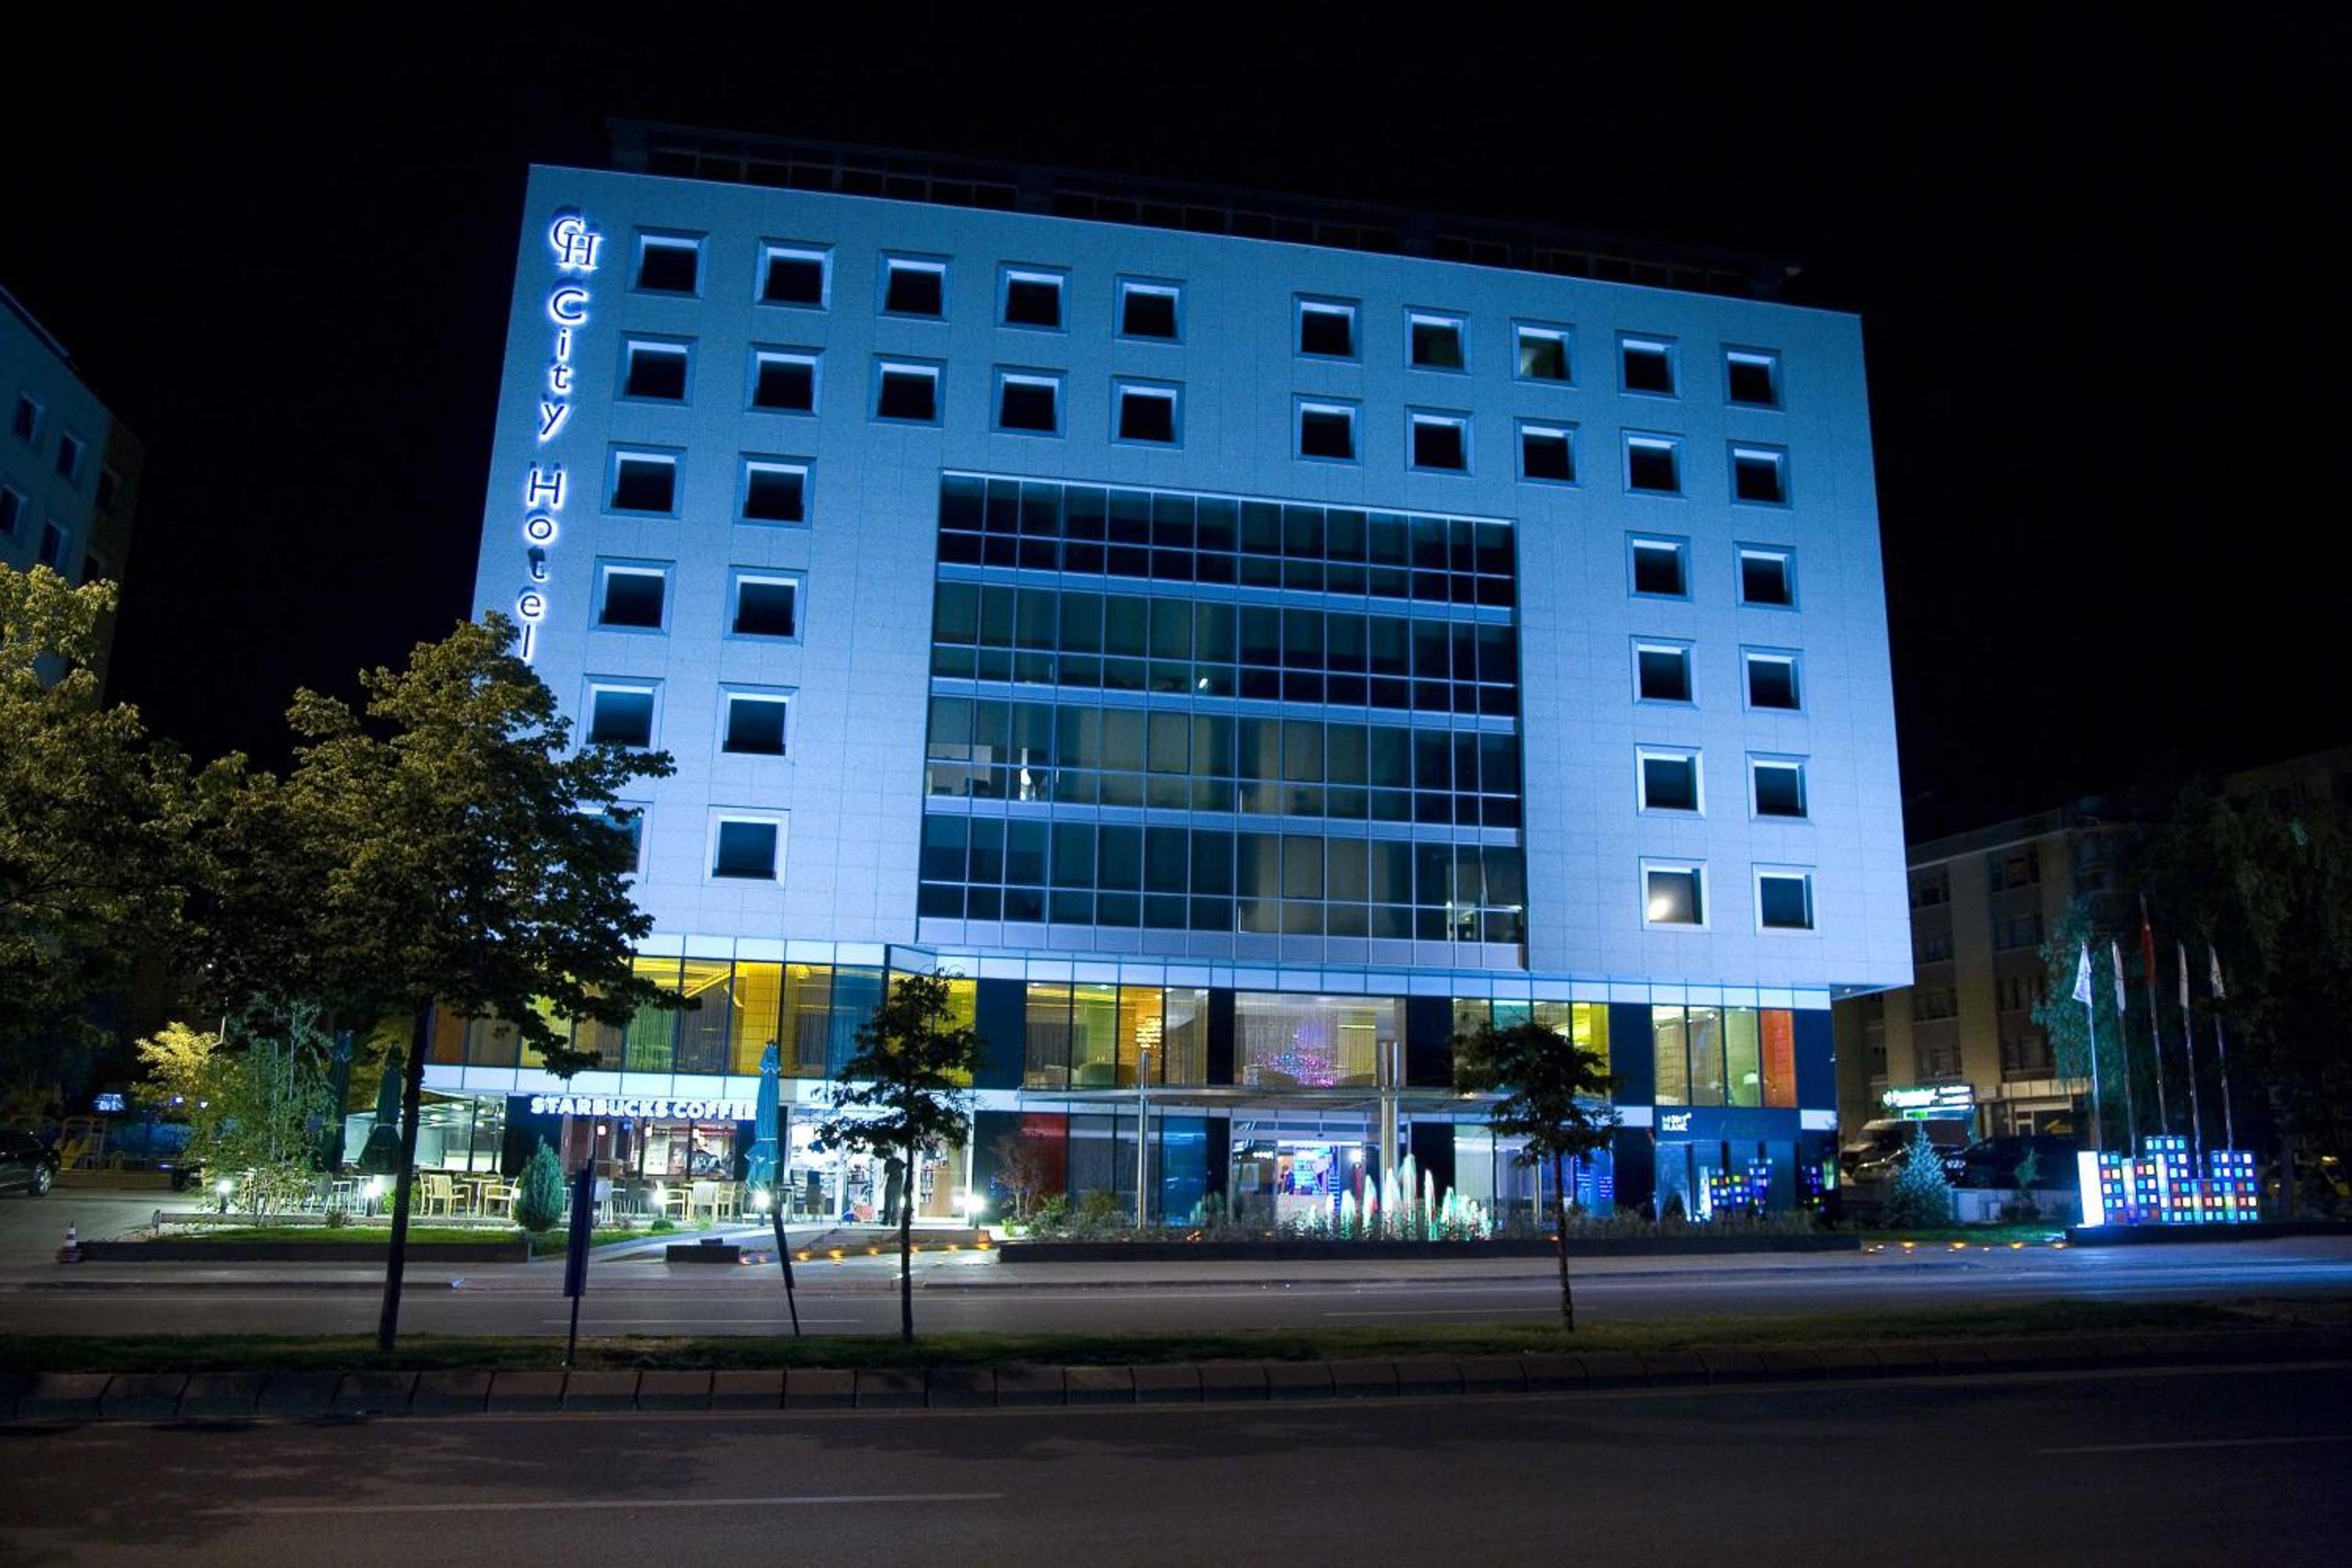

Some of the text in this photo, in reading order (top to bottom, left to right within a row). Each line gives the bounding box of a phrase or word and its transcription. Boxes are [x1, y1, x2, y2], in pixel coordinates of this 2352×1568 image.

[519, 288, 587, 659] City Hotel
[531, 1097, 668, 1118] STARBUCKS
